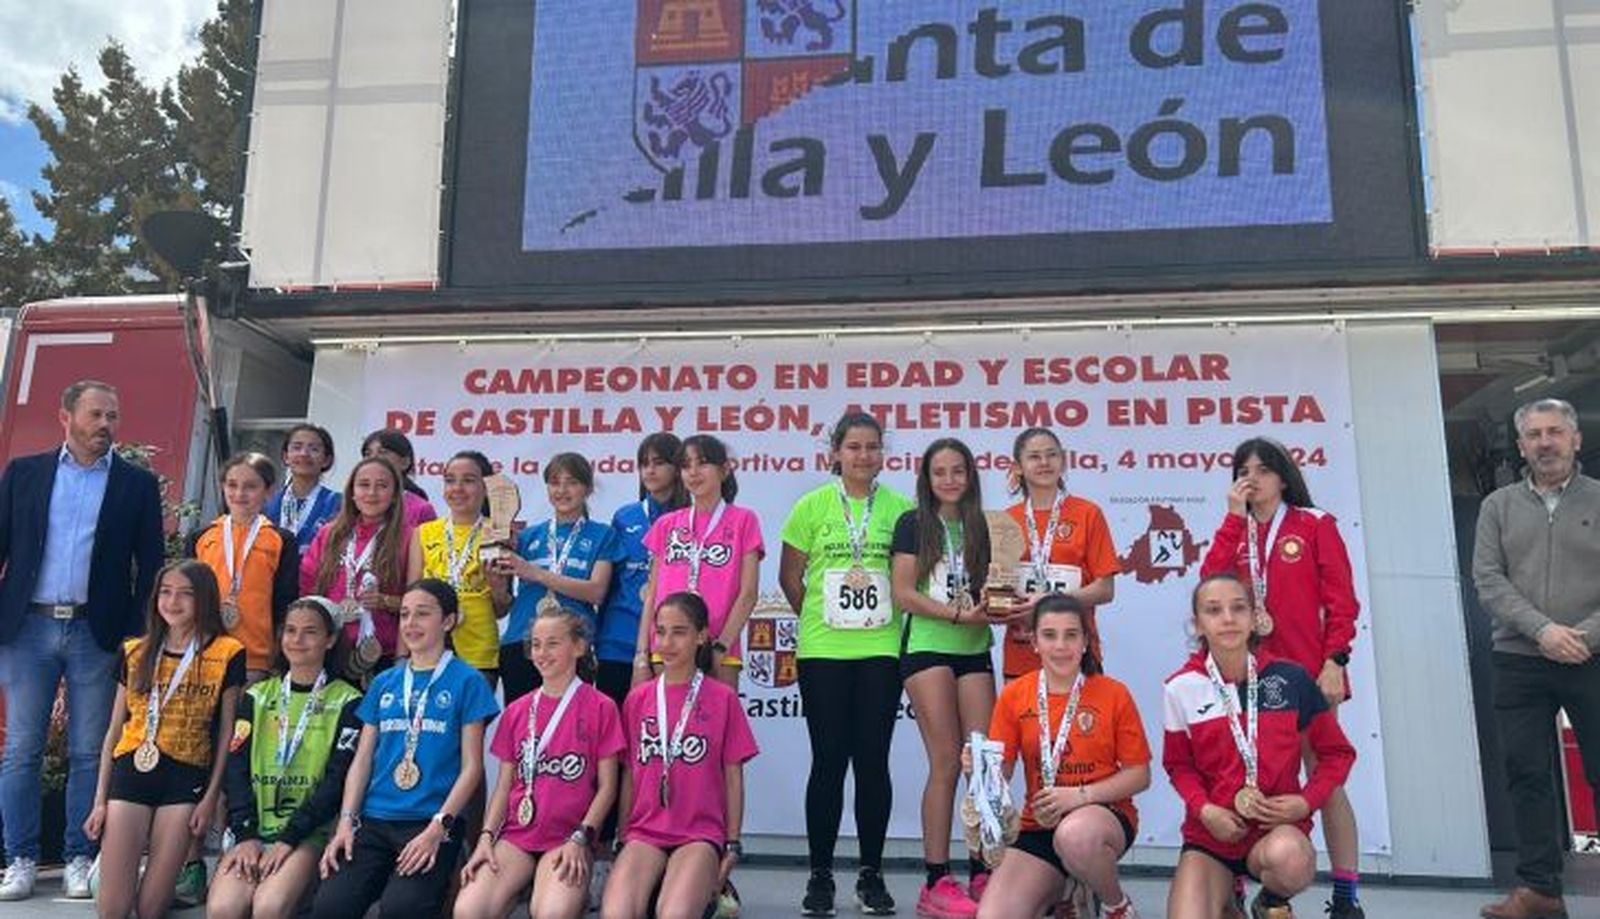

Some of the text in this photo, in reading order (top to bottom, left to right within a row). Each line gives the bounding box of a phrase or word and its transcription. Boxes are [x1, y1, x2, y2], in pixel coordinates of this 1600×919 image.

[1128, 1, 1290, 71] de
[859, 131, 937, 221] y
[980, 97, 1296, 190] León
[464, 353, 1231, 395] CAMPEONATO EN EDAD Y ESCOLAR
[386, 410, 436, 436] DE
[450, 407, 642, 435] CASTILLA
[655, 406, 682, 432] Y
[697, 400, 824, 437] LEÓN,
[1107, 399, 1169, 427] EN
[1187, 396, 1326, 424] PISTA
[513, 457, 539, 474] la
[727, 452, 805, 473] ortiva
[974, 451, 1011, 471] de
[1117, 449, 1137, 469] 4
[1147, 451, 1235, 474] mayo
[839, 584, 878, 611] 586
